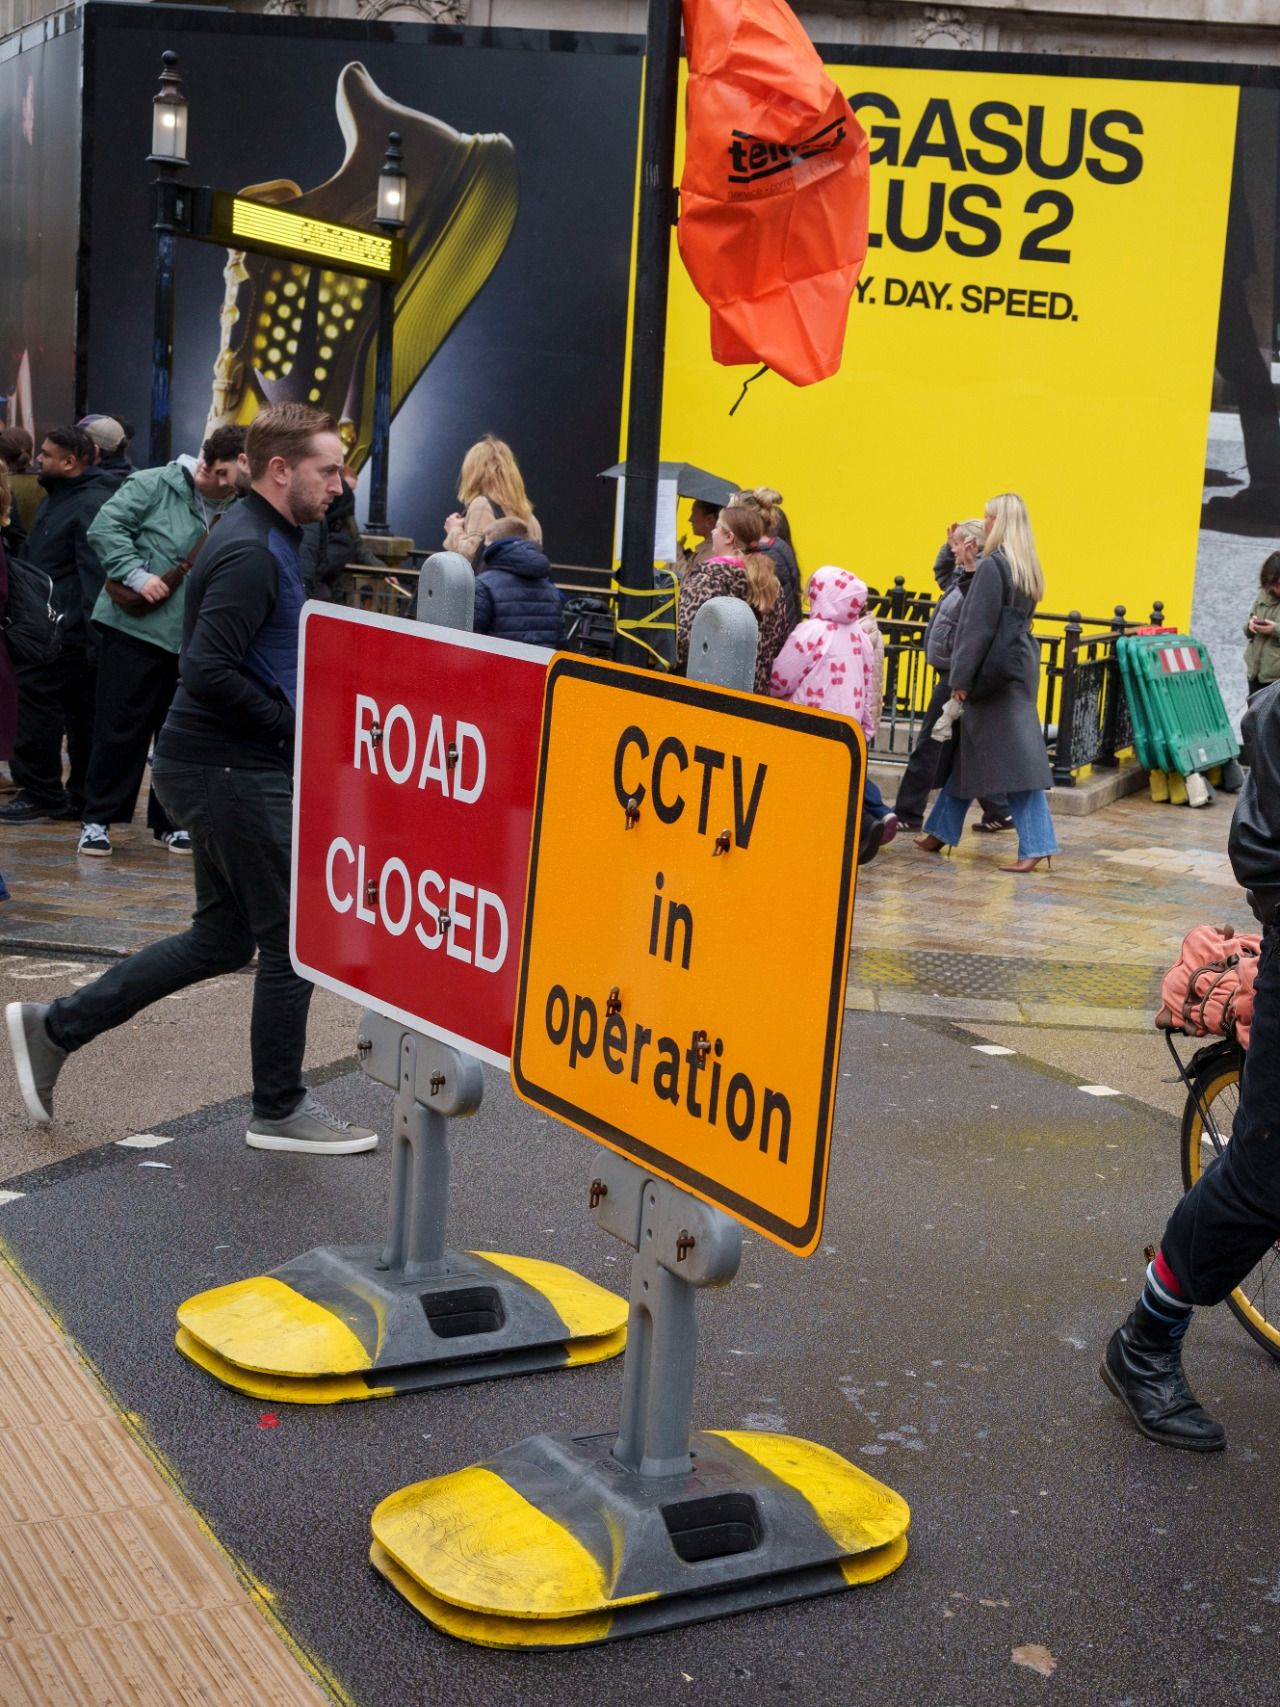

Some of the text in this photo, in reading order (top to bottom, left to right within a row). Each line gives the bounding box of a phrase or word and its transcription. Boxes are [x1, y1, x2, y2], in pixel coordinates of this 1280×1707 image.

[846, 91, 1145, 186] GASUS
[867, 178, 1075, 264] US 2
[884, 277, 953, 311] DAY.
[960, 284, 1079, 322] SPEED.
[354, 693, 487, 805] ROAD
[613, 725, 768, 850] CCTV
[325, 836, 509, 974] CLOSED
[649, 871, 694, 971] in
[545, 983, 792, 1165] operation
